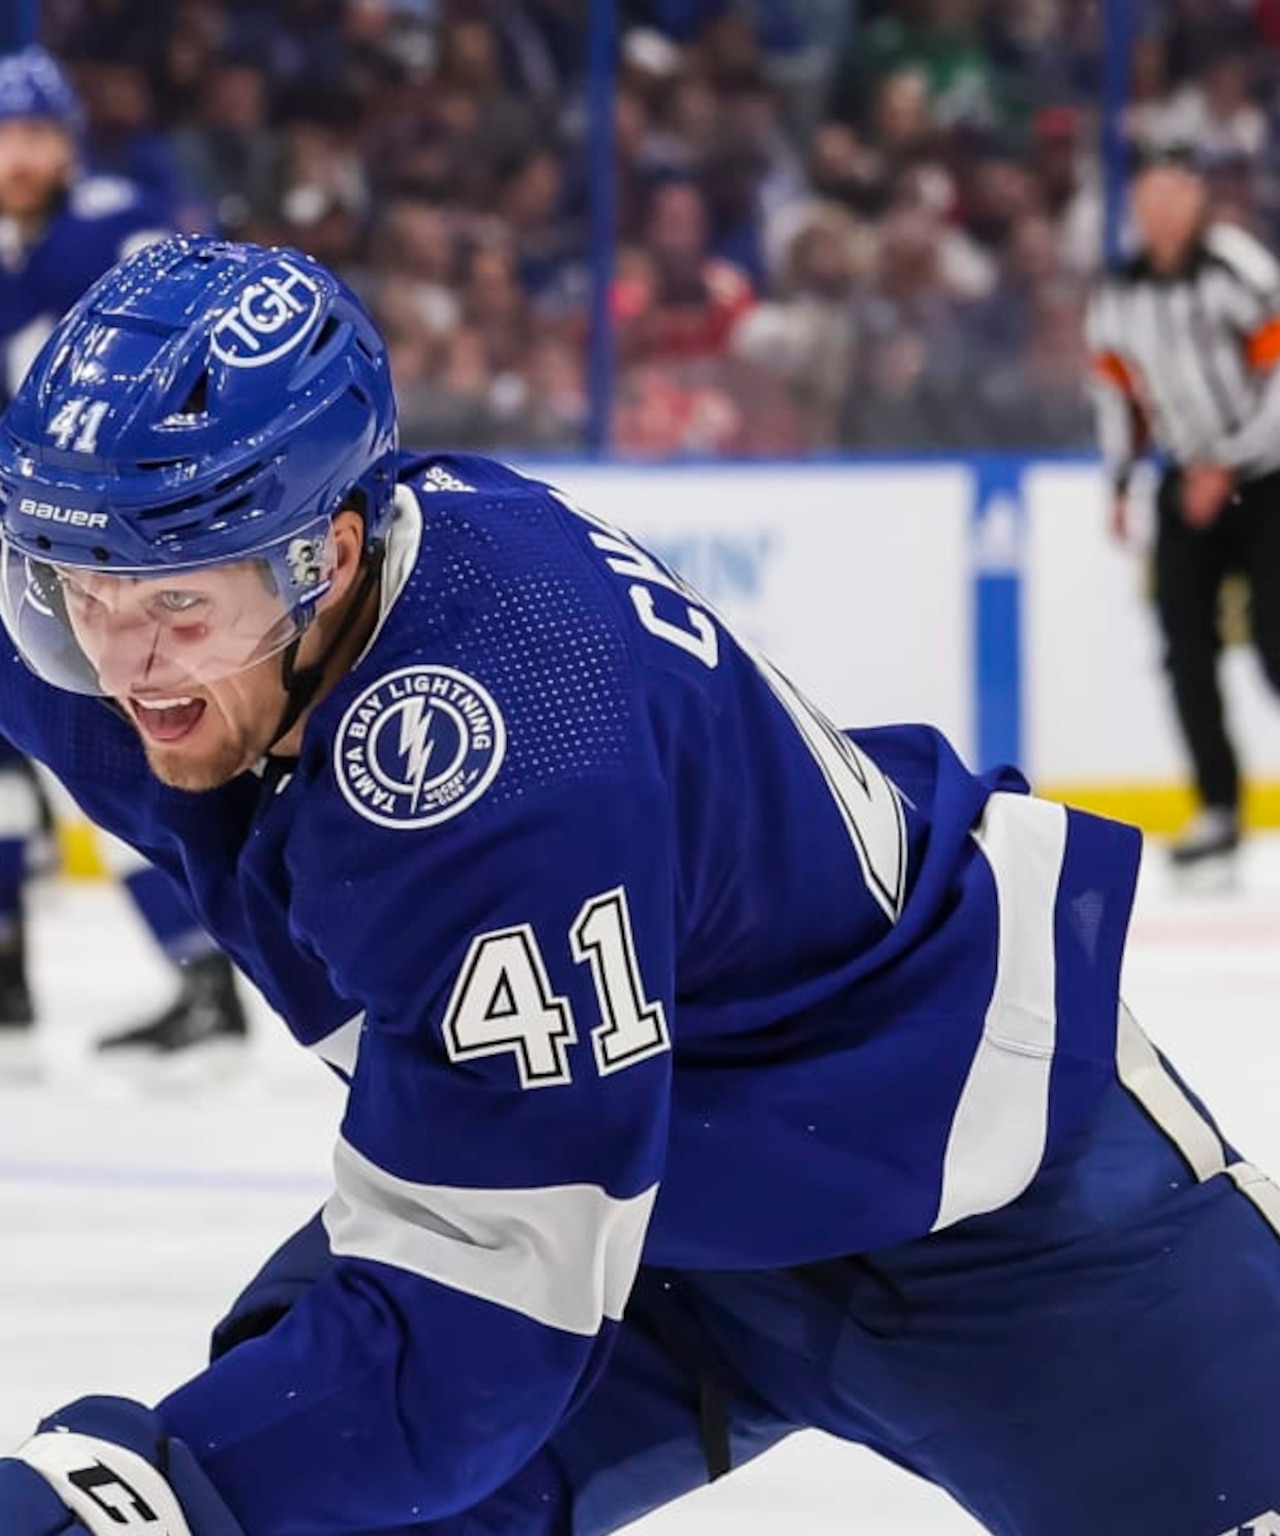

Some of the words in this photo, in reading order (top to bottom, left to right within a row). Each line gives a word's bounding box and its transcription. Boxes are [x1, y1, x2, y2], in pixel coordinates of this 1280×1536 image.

[215, 261, 318, 351] TGH
[45, 395, 110, 454] 41
[19, 498, 109, 530] BAUER
[348, 694, 384, 740] BAY
[388, 674, 492, 750] LIGHTNING
[345, 746, 397, 813] TAMPA
[442, 886, 671, 1090] 41
